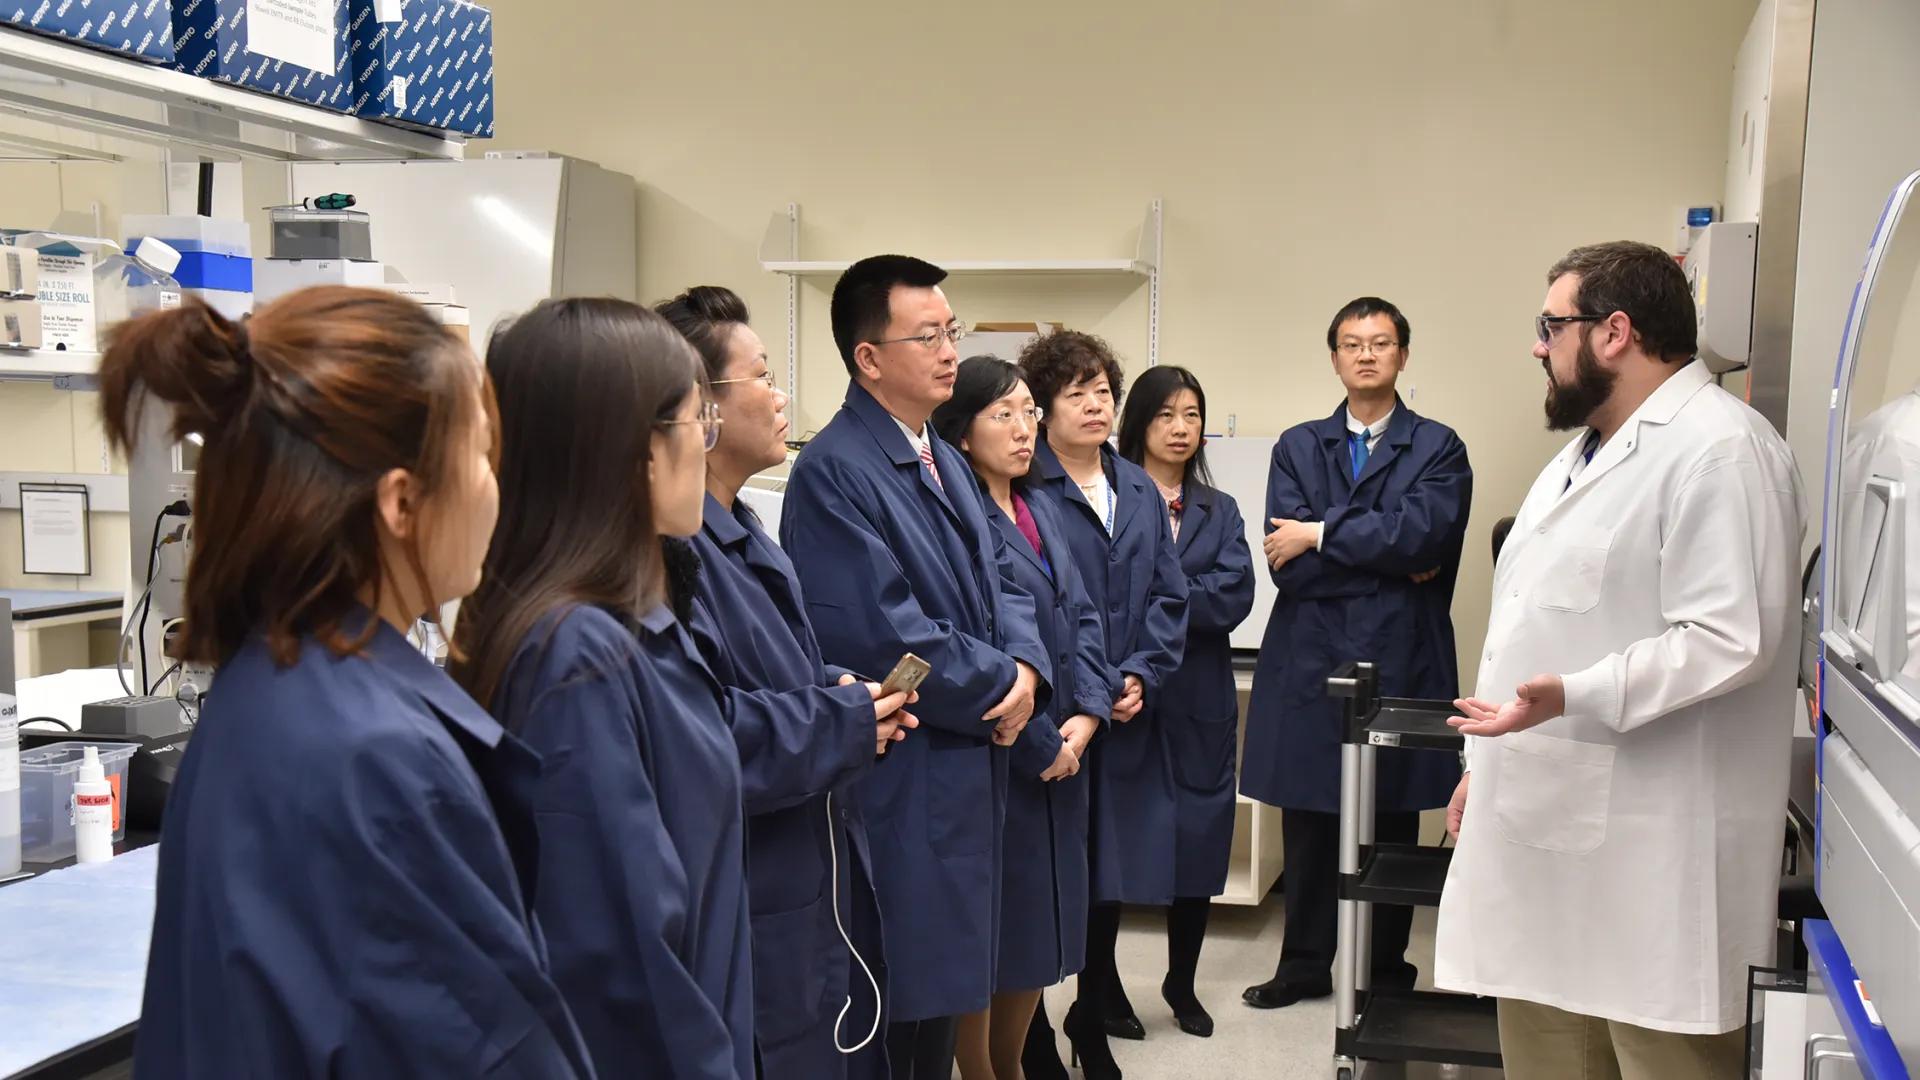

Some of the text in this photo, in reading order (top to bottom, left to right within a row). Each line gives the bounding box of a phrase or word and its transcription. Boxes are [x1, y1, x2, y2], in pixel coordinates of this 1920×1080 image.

[98, 11, 115, 37] QIAGEN
[121, 2, 139, 28] QIAGEN
[229, 7, 245, 30] QIAGEN
[352, 6, 371, 30] QIAGEN
[413, 12, 428, 33] QIAGEN
[432, 5, 446, 27] QIAGEN
[204, 14, 225, 39] QIAGEN
[369, 23, 389, 50] QIAGEN
[394, 19, 409, 40] QIAGEN
[443, 27, 457, 48] QIAGEN
[460, 20, 474, 41] QIAGEN
[136, 29, 154, 55] QIAGEN
[223, 40, 239, 64] QIAGEN
[407, 41, 421, 63] QIAGEN
[425, 34, 440, 56] QIAGEN
[471, 42, 485, 63] QIAGEN
[193, 49, 217, 76] QIAGEN
[255, 58, 270, 80] QIAGEN
[336, 50, 348, 72] QIAGEN
[386, 48, 402, 71] QIAGEN
[437, 56, 451, 78] QIAGEN
[454, 49, 468, 71] QIAGEN
[360, 59, 379, 83] QIAGEN
[419, 64, 433, 86] QIAGEN
[465, 71, 479, 92] QIAGEN
[284, 73, 300, 97] QIAGEN
[330, 82, 343, 104] QIAGEN
[448, 79, 462, 100] QIAGEN
[351, 91, 370, 115] QIAGEN
[412, 94, 426, 116] QIAGEN
[430, 86, 444, 108] QIAGEN
[476, 93, 489, 113] QIAGEN
[458, 100, 473, 121] QIAGEN
[37, 290, 54, 301] UBLE
[55, 291, 70, 302] SIZE
[72, 293, 91, 304] ROLL
